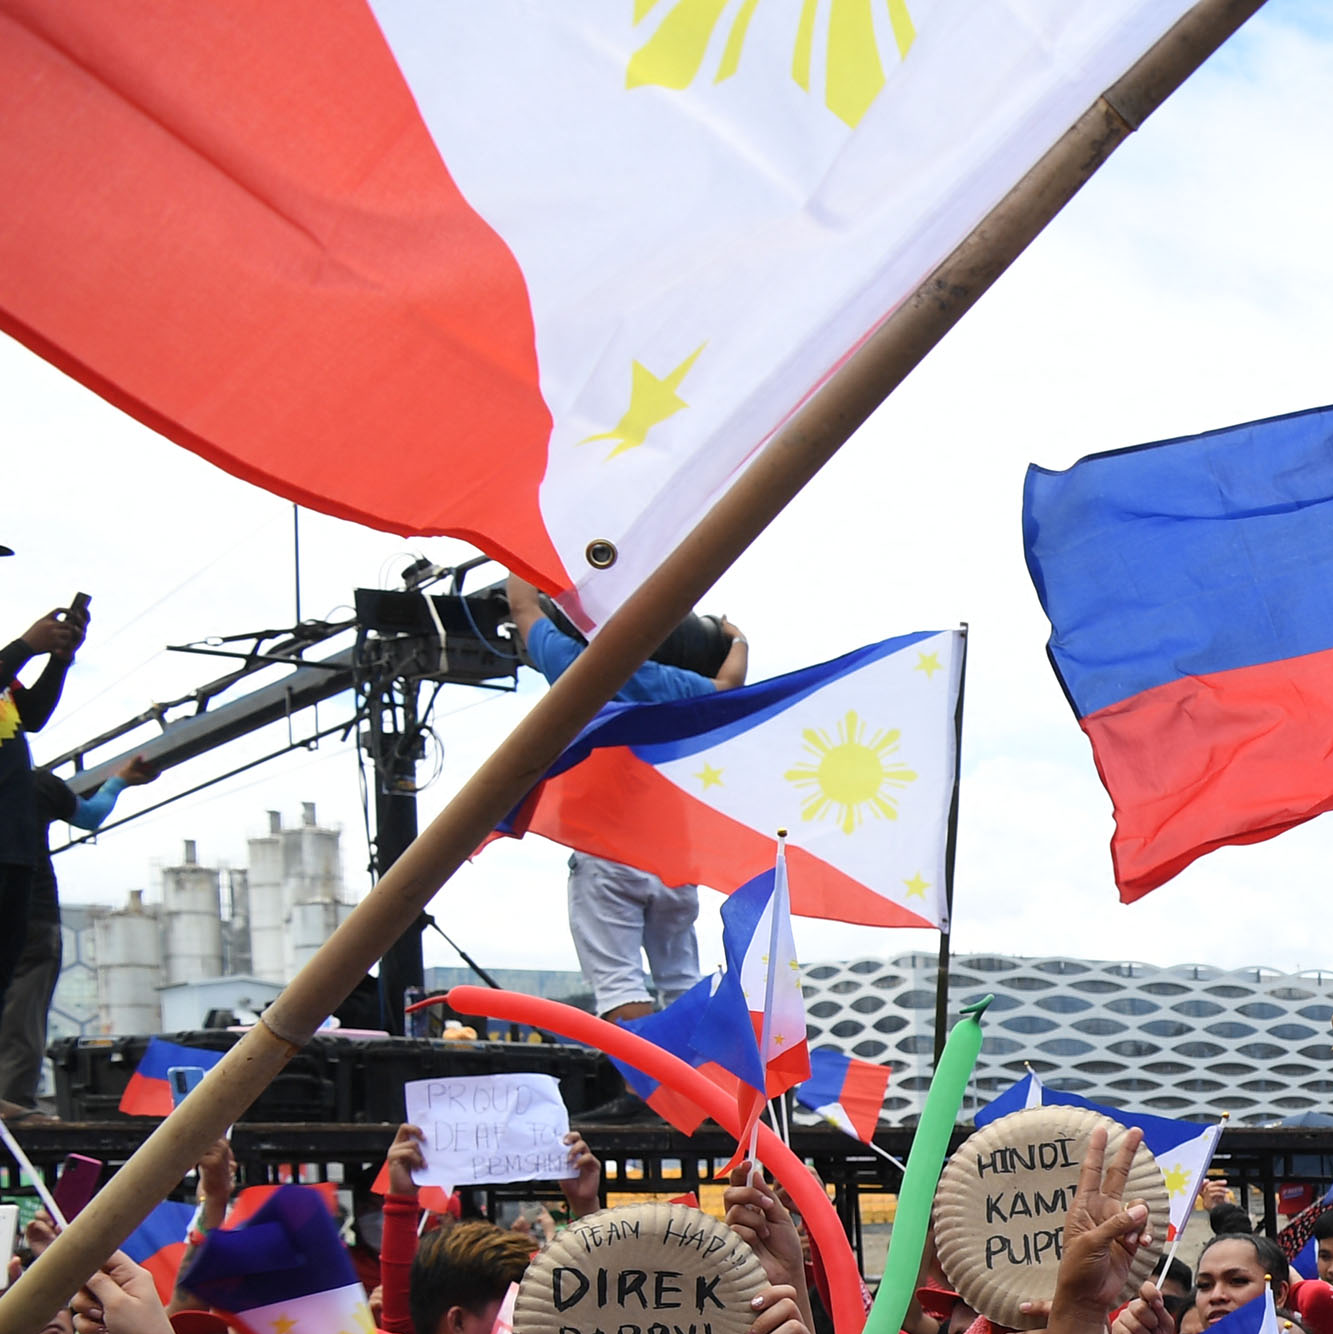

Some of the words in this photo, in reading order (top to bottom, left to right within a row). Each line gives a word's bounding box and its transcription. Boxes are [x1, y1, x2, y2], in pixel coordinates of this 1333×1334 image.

[427, 1083, 533, 1115] PROUD
[977, 1132, 1079, 1178] HINDI
[574, 1220, 640, 1253] TEAM
[552, 1266, 726, 1315] DIREK
